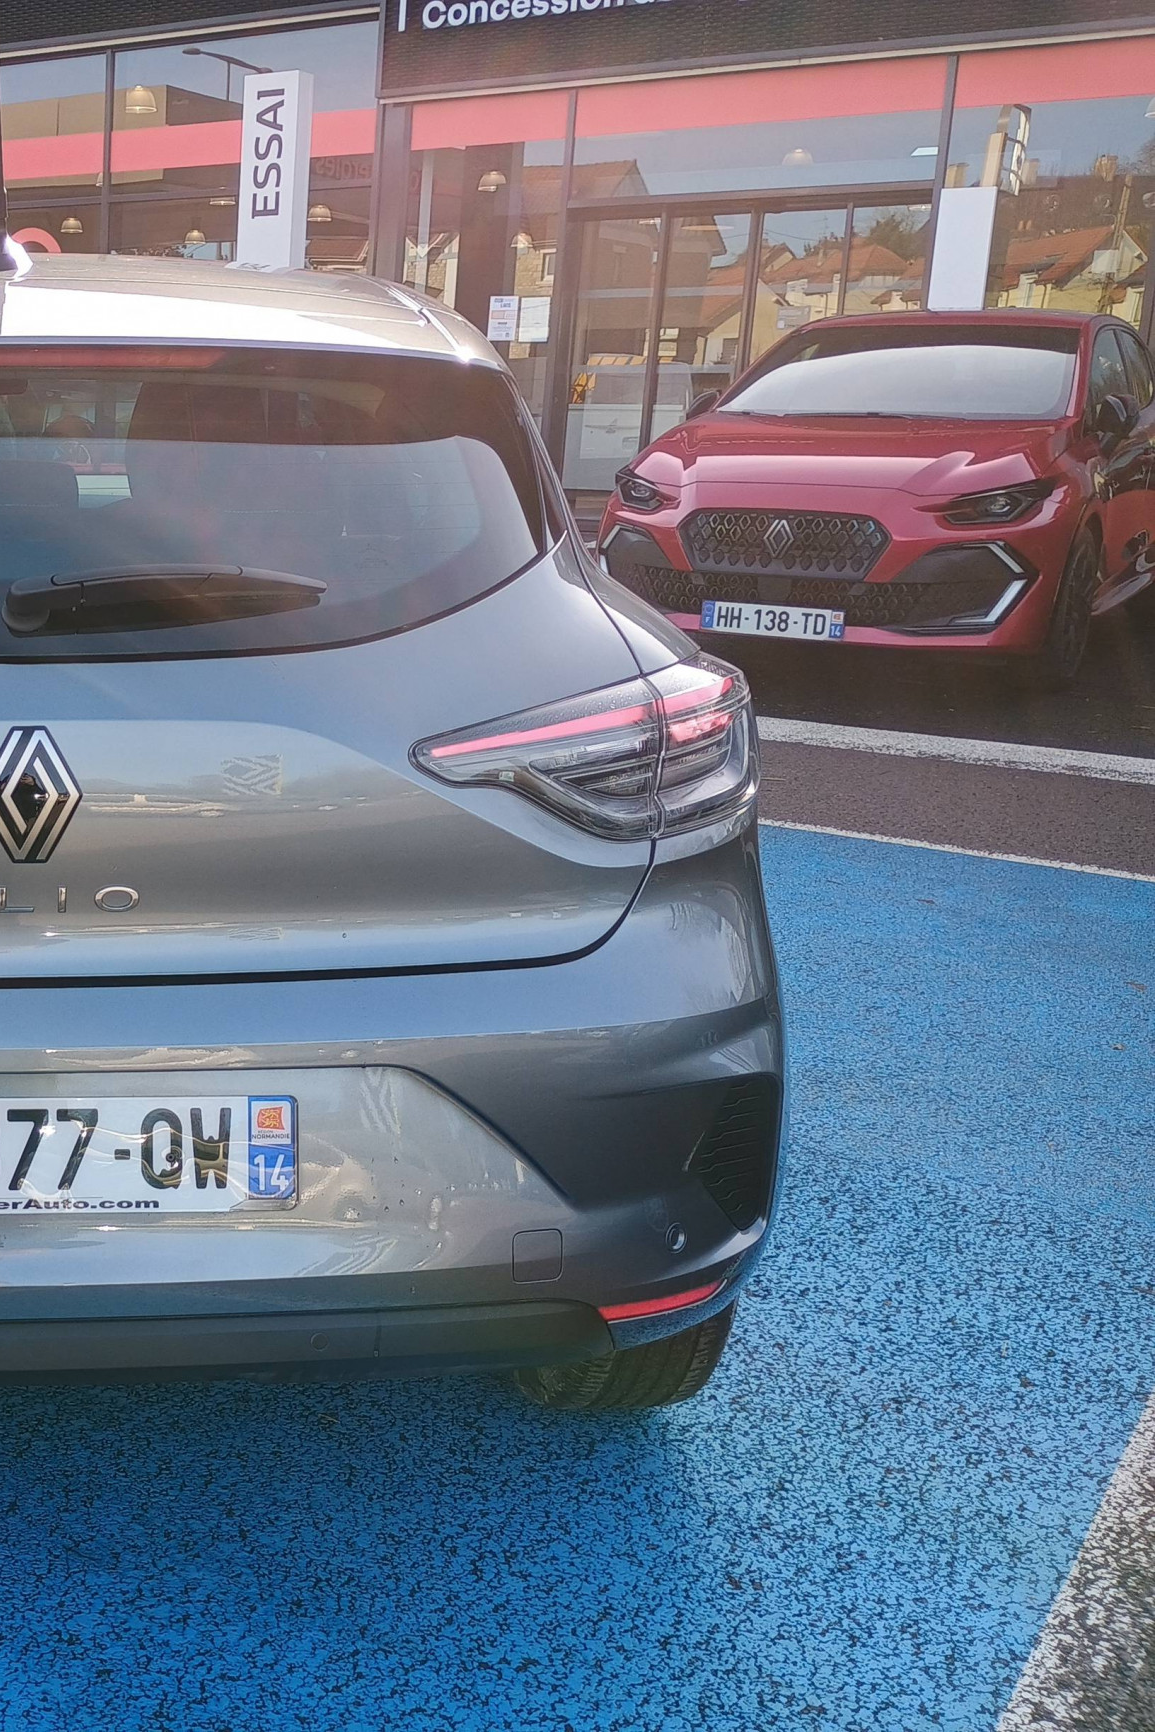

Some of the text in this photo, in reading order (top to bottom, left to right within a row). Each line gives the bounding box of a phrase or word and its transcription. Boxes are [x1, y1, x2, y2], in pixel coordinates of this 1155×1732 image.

[251, 88, 285, 219] ESSAI
[716, 606, 827, 636] HH-138-TD
[831, 626, 841, 637] 14
[253, 1154, 289, 1191] 14
